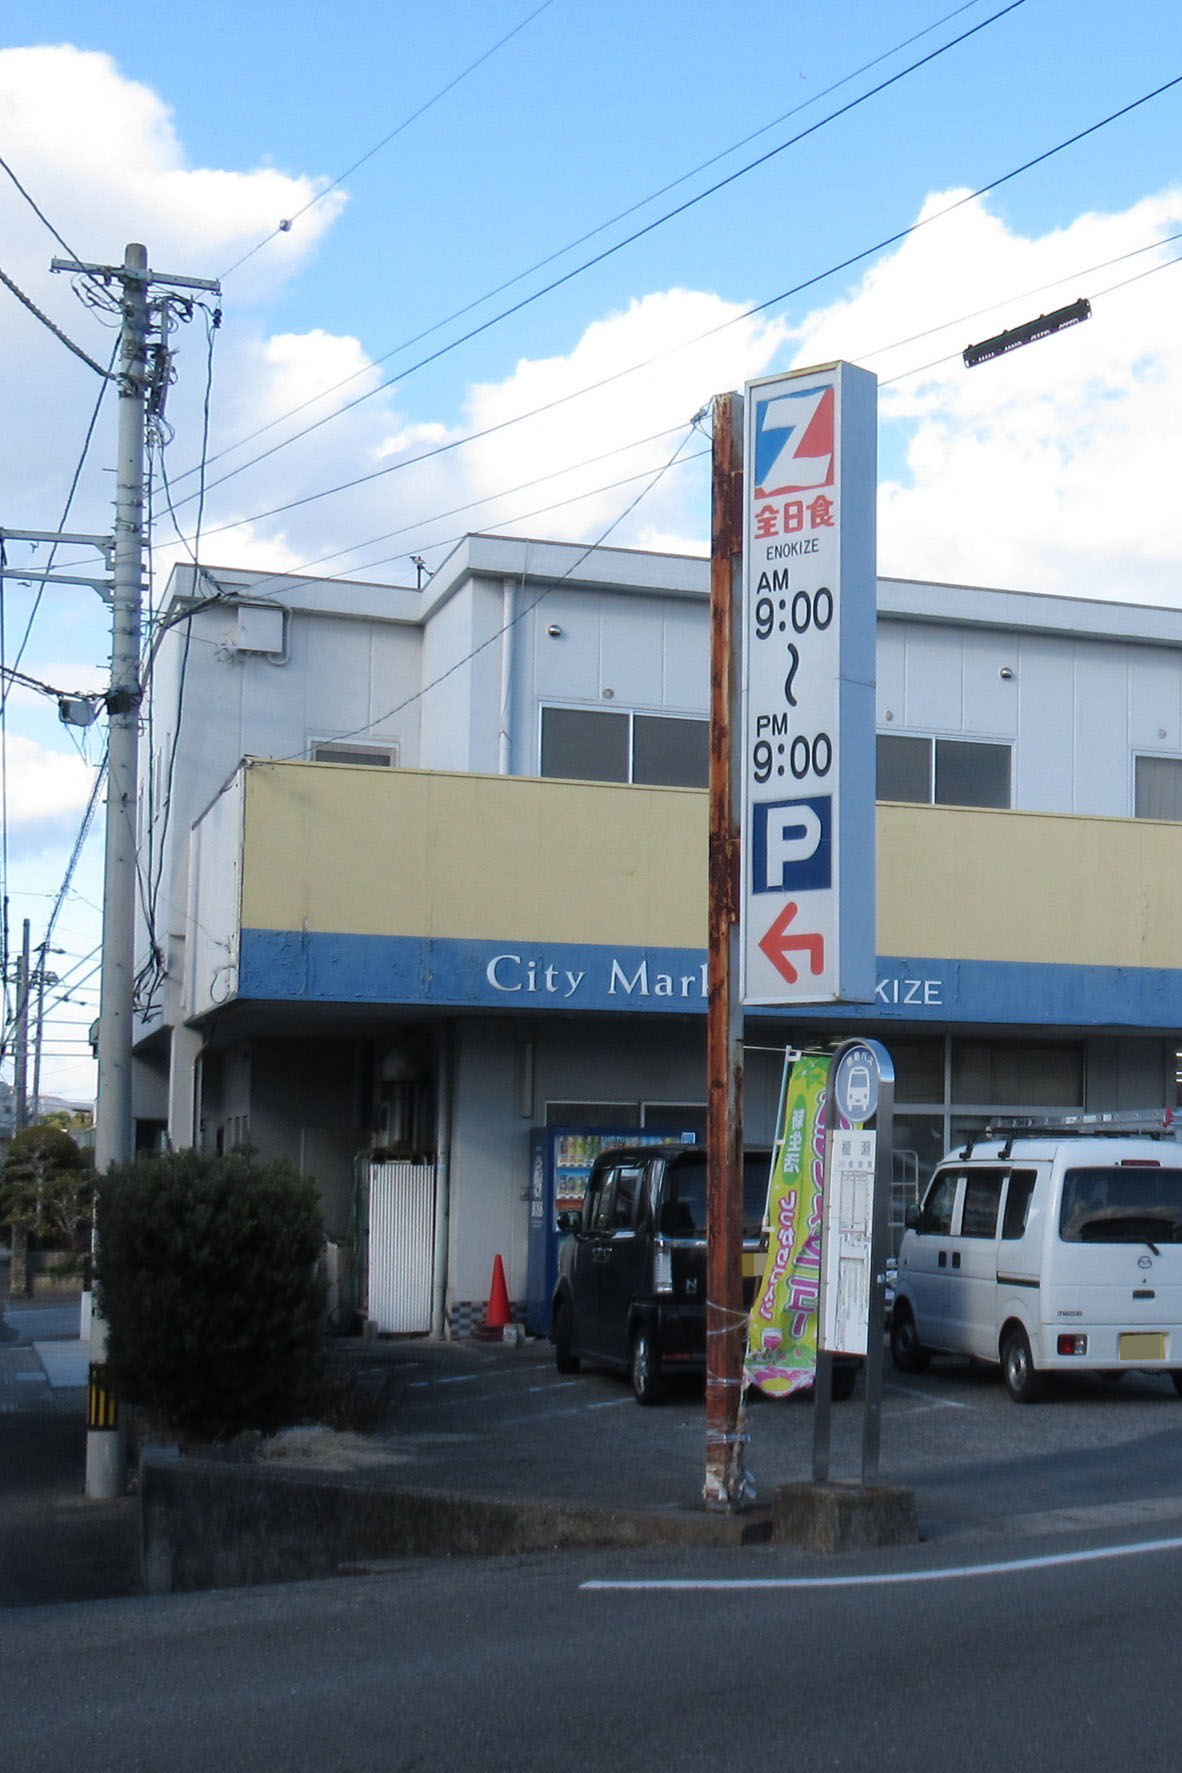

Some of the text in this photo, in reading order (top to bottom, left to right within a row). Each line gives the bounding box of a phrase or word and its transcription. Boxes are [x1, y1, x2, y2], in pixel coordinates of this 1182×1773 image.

[754, 495, 835, 540] 全日食
[766, 538, 820, 561] ENOKIZE
[756, 568, 789, 594] AM
[755, 587, 833, 640] 9:00
[756, 713, 788, 738] PM
[753, 733, 832, 784] 9:00
[766, 804, 822, 888] P
[486, 954, 586, 998] City
